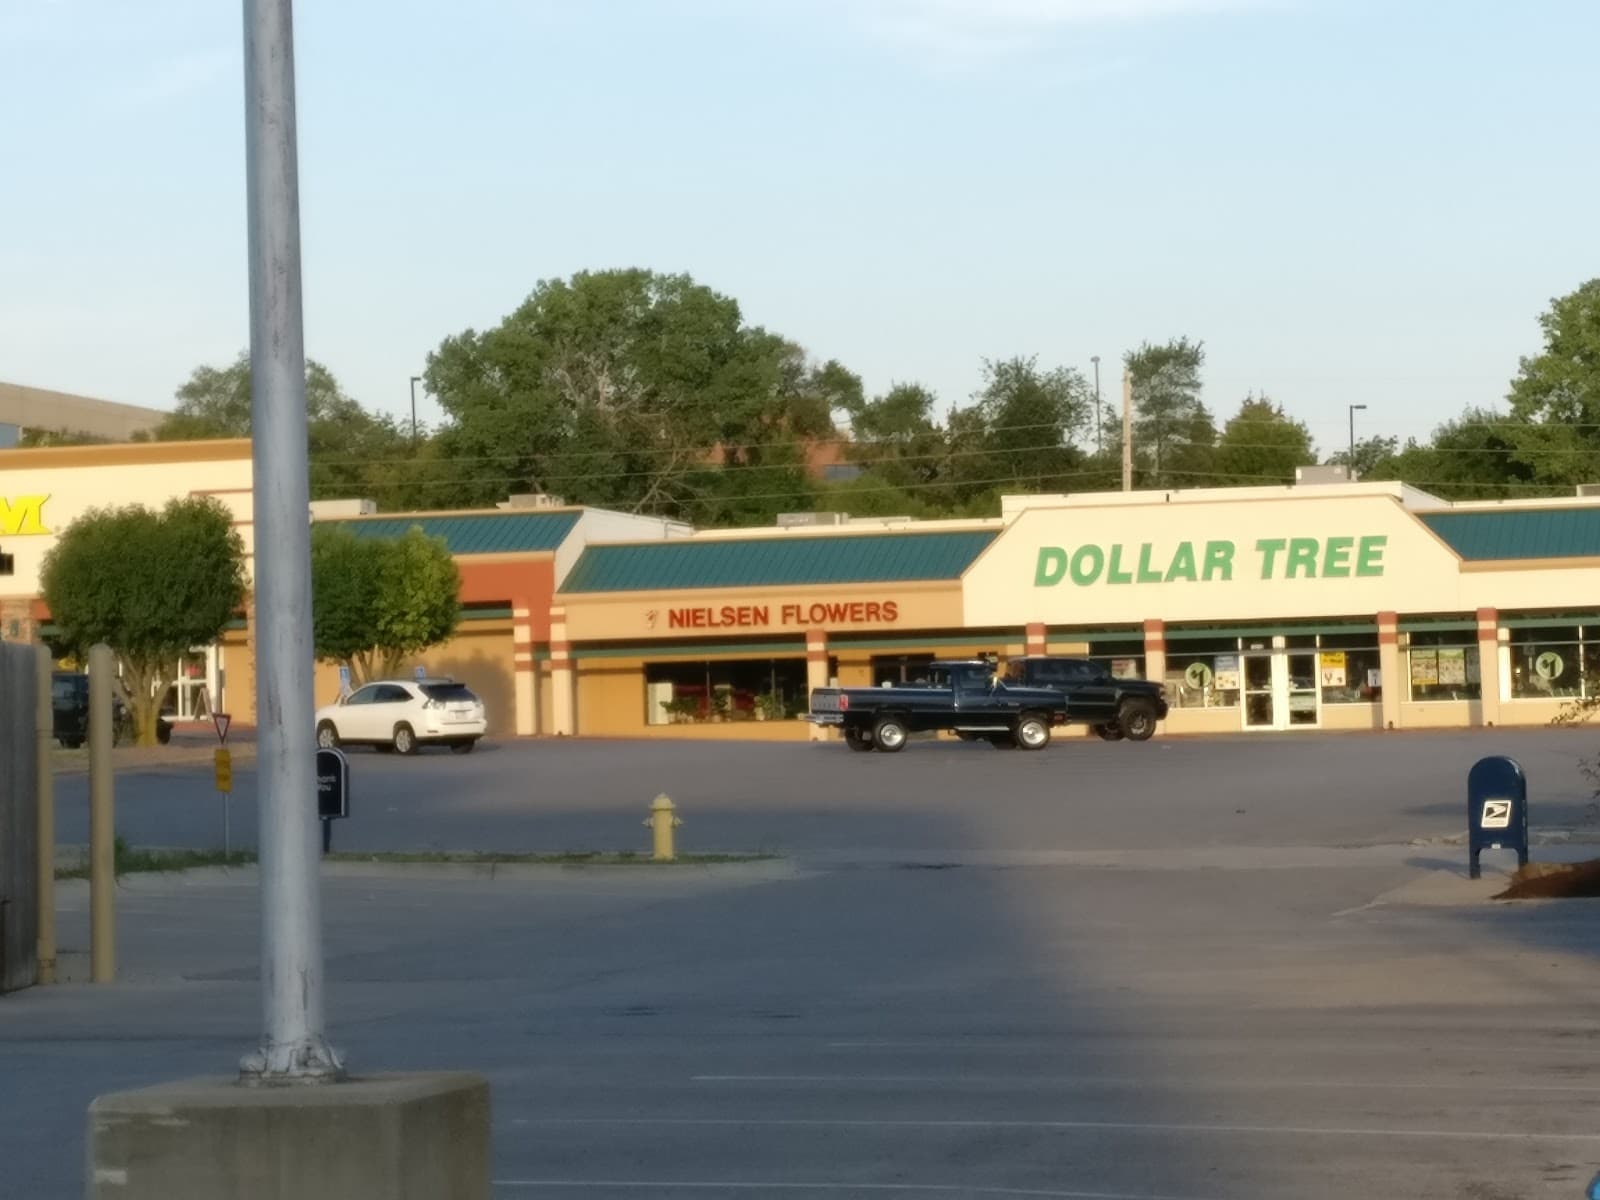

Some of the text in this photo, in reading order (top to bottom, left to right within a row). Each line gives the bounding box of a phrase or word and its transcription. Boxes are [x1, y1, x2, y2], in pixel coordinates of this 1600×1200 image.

[1033, 534, 1389, 587] DOLLAR TREE
[668, 600, 899, 629] NIELSEN FLOWERS
